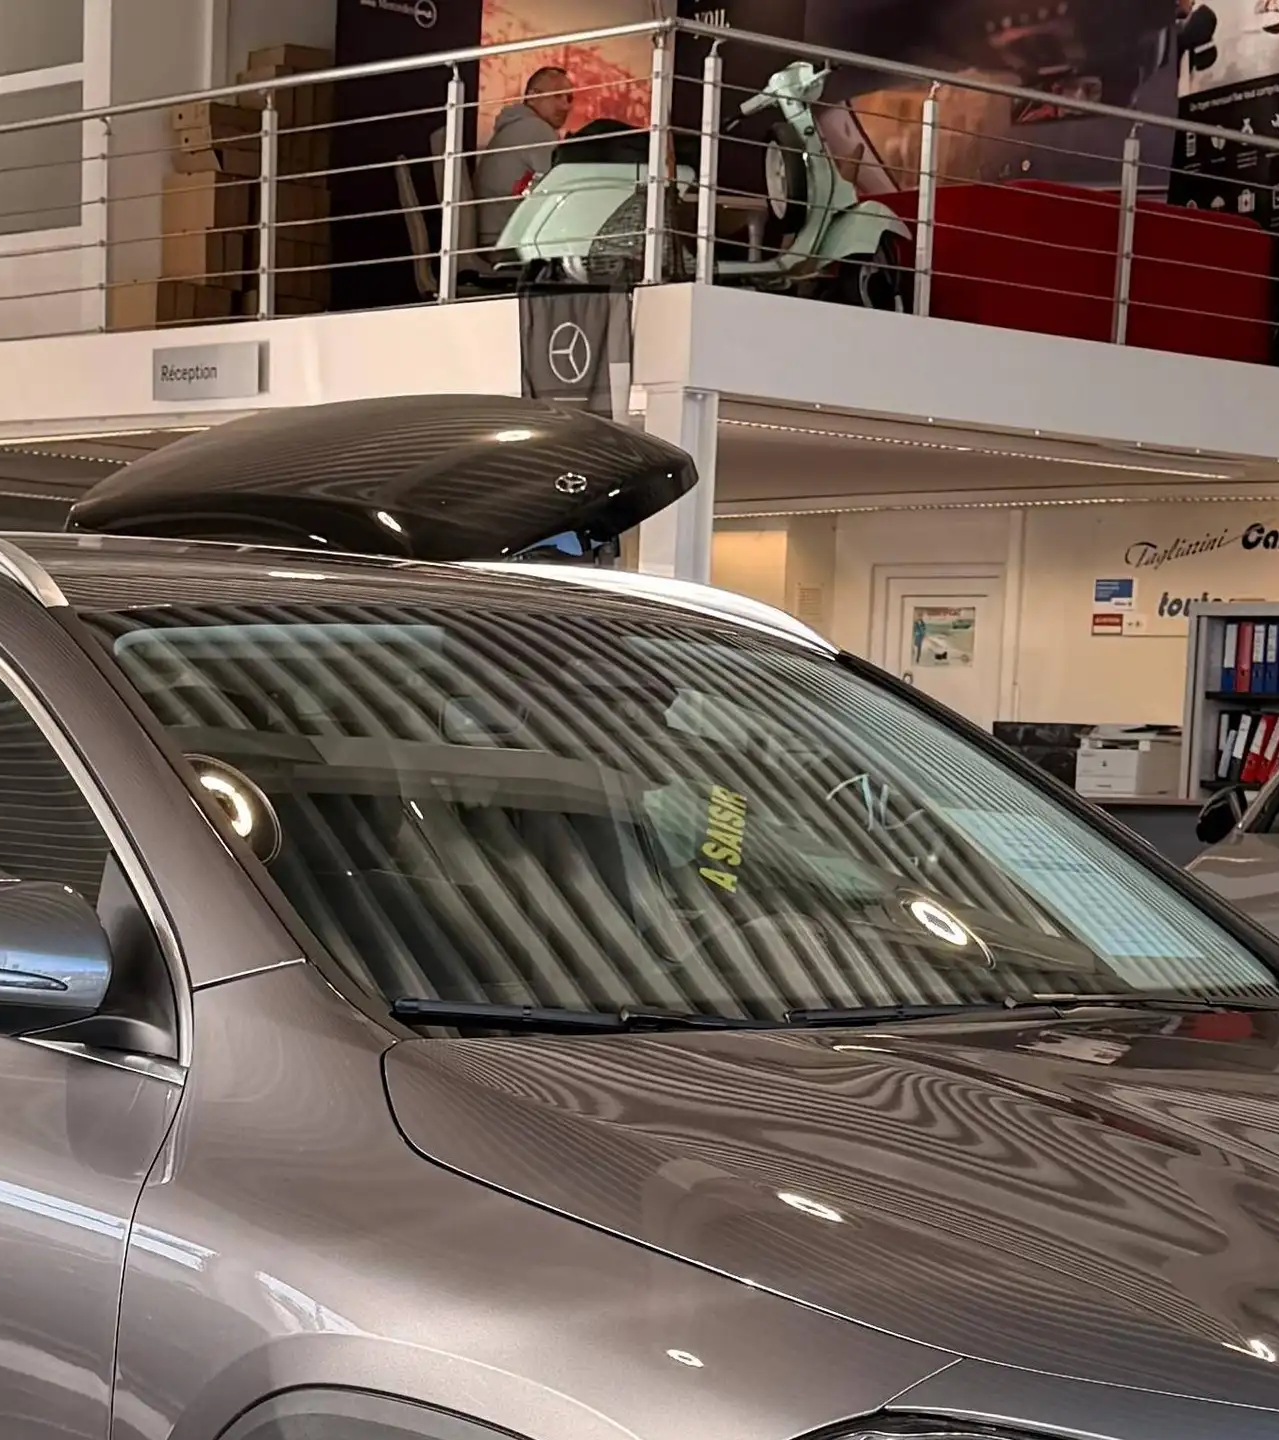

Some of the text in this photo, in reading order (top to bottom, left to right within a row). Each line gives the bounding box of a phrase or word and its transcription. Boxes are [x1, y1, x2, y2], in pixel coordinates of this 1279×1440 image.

[160, 364, 218, 384] Réception
[699, 785, 748, 893] A SAISIR
